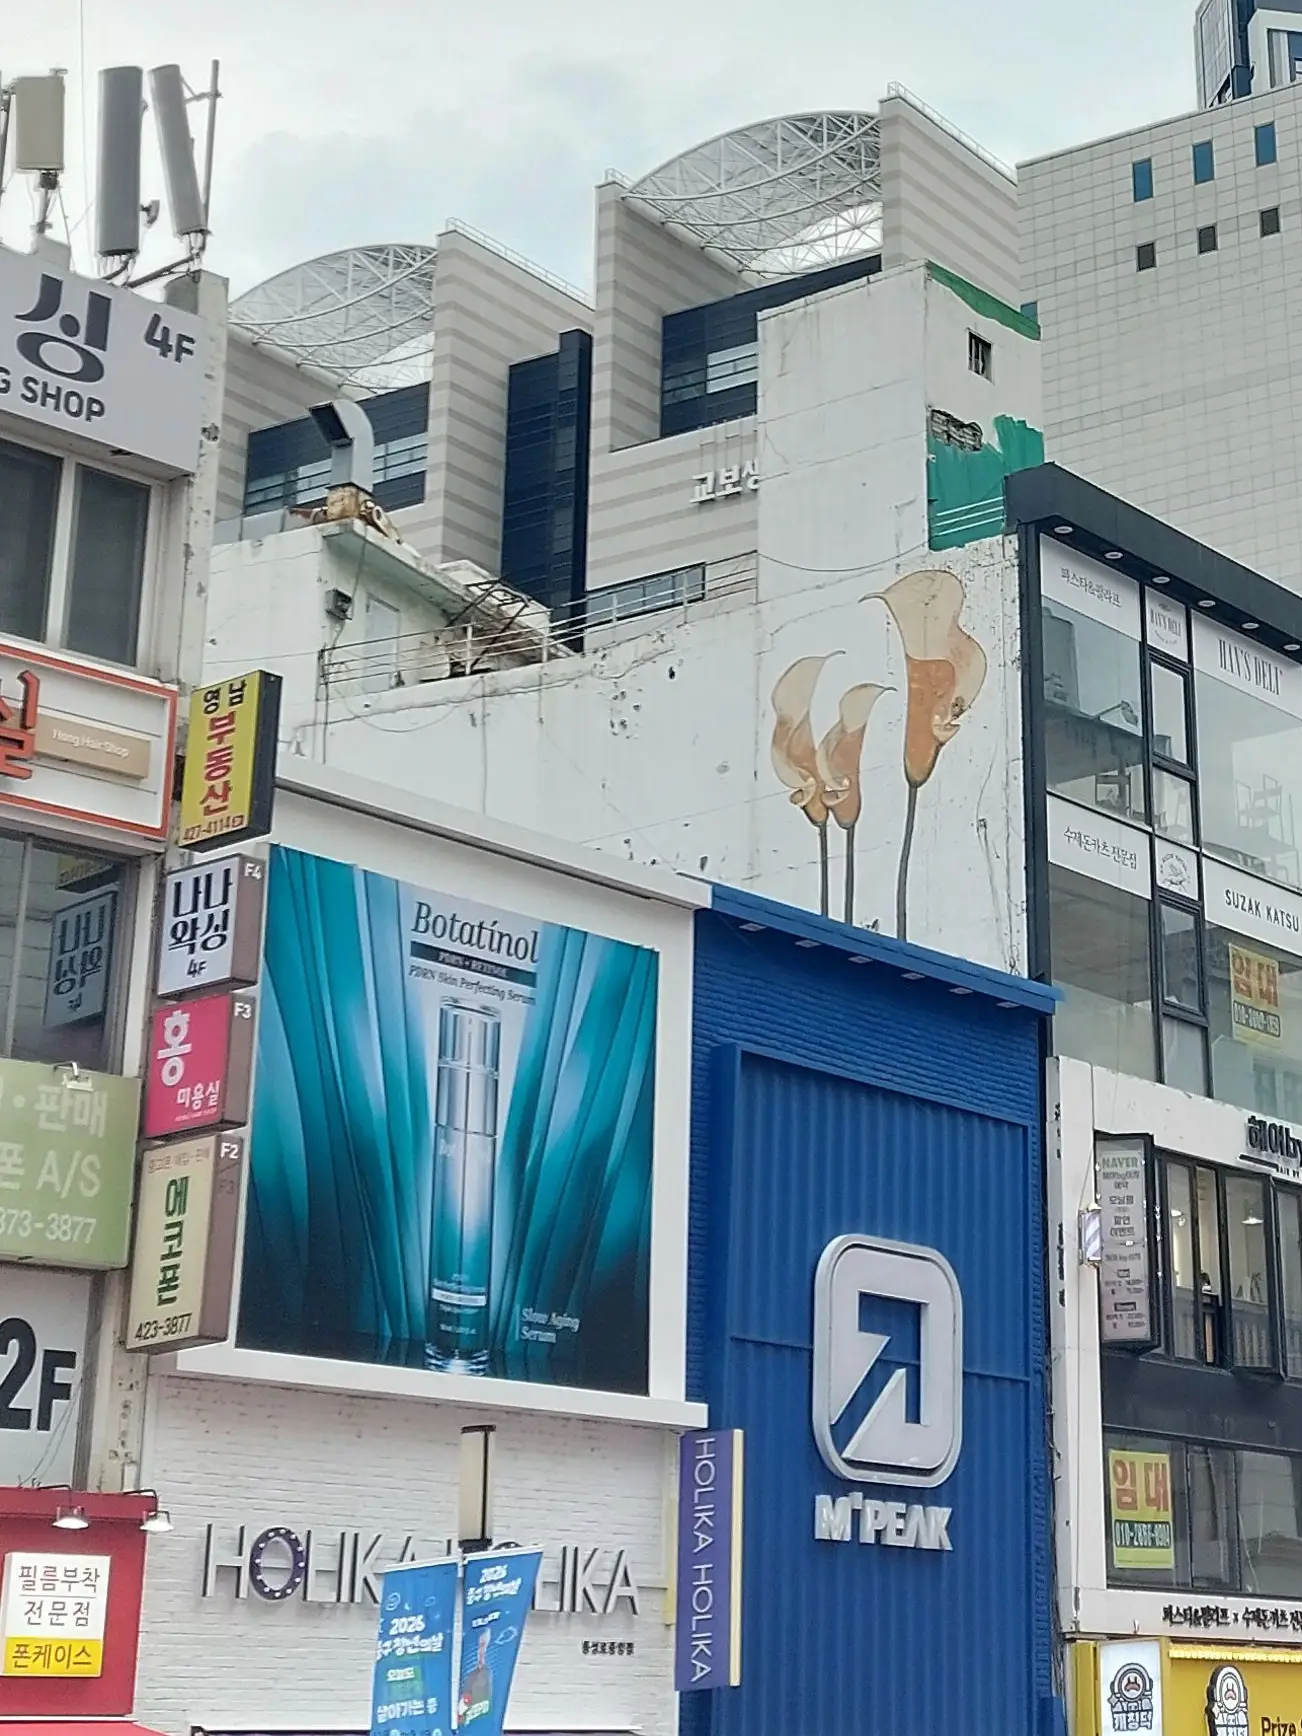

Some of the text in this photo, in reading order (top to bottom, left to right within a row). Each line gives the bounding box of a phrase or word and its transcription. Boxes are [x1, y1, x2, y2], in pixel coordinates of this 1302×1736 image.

[144, 313, 196, 363] 4F
[20, 376, 105, 423] SHOP
[1219, 639, 1280, 695] HAN'S DELI
[203, 678, 247, 715] 영남
[199, 711, 236, 816] 부동산
[244, 862, 262, 880] F4
[173, 867, 233, 918] 나나
[1225, 889, 1300, 932] SUZAK KATSU
[168, 908, 230, 955] 왁싱
[186, 958, 207, 978] 4F
[234, 1002, 252, 1019] F3
[157, 1009, 192, 1087] 홍
[176, 1080, 221, 1111] 미용실
[220, 1142, 240, 1159] F2
[1102, 1157, 1138, 1169] NAVER
[36, 1149, 101, 1199] A/S
[0, 1207, 96, 1244] 73-3877
[156, 1175, 190, 1307] 에코폰
[134, 1312, 193, 1341] 423-3877
[0, 1317, 76, 1431] 2F
[1113, 1460, 1168, 1511] 임대
[18, 1565, 100, 1593] 필름부착
[690, 1437, 716, 1683] HOLIKA HOLIKA
[24, 1600, 90, 1627] 전문점
[12, 1643, 92, 1669] 폰케이스
[1261, 1717, 1296, 1736] Prize
